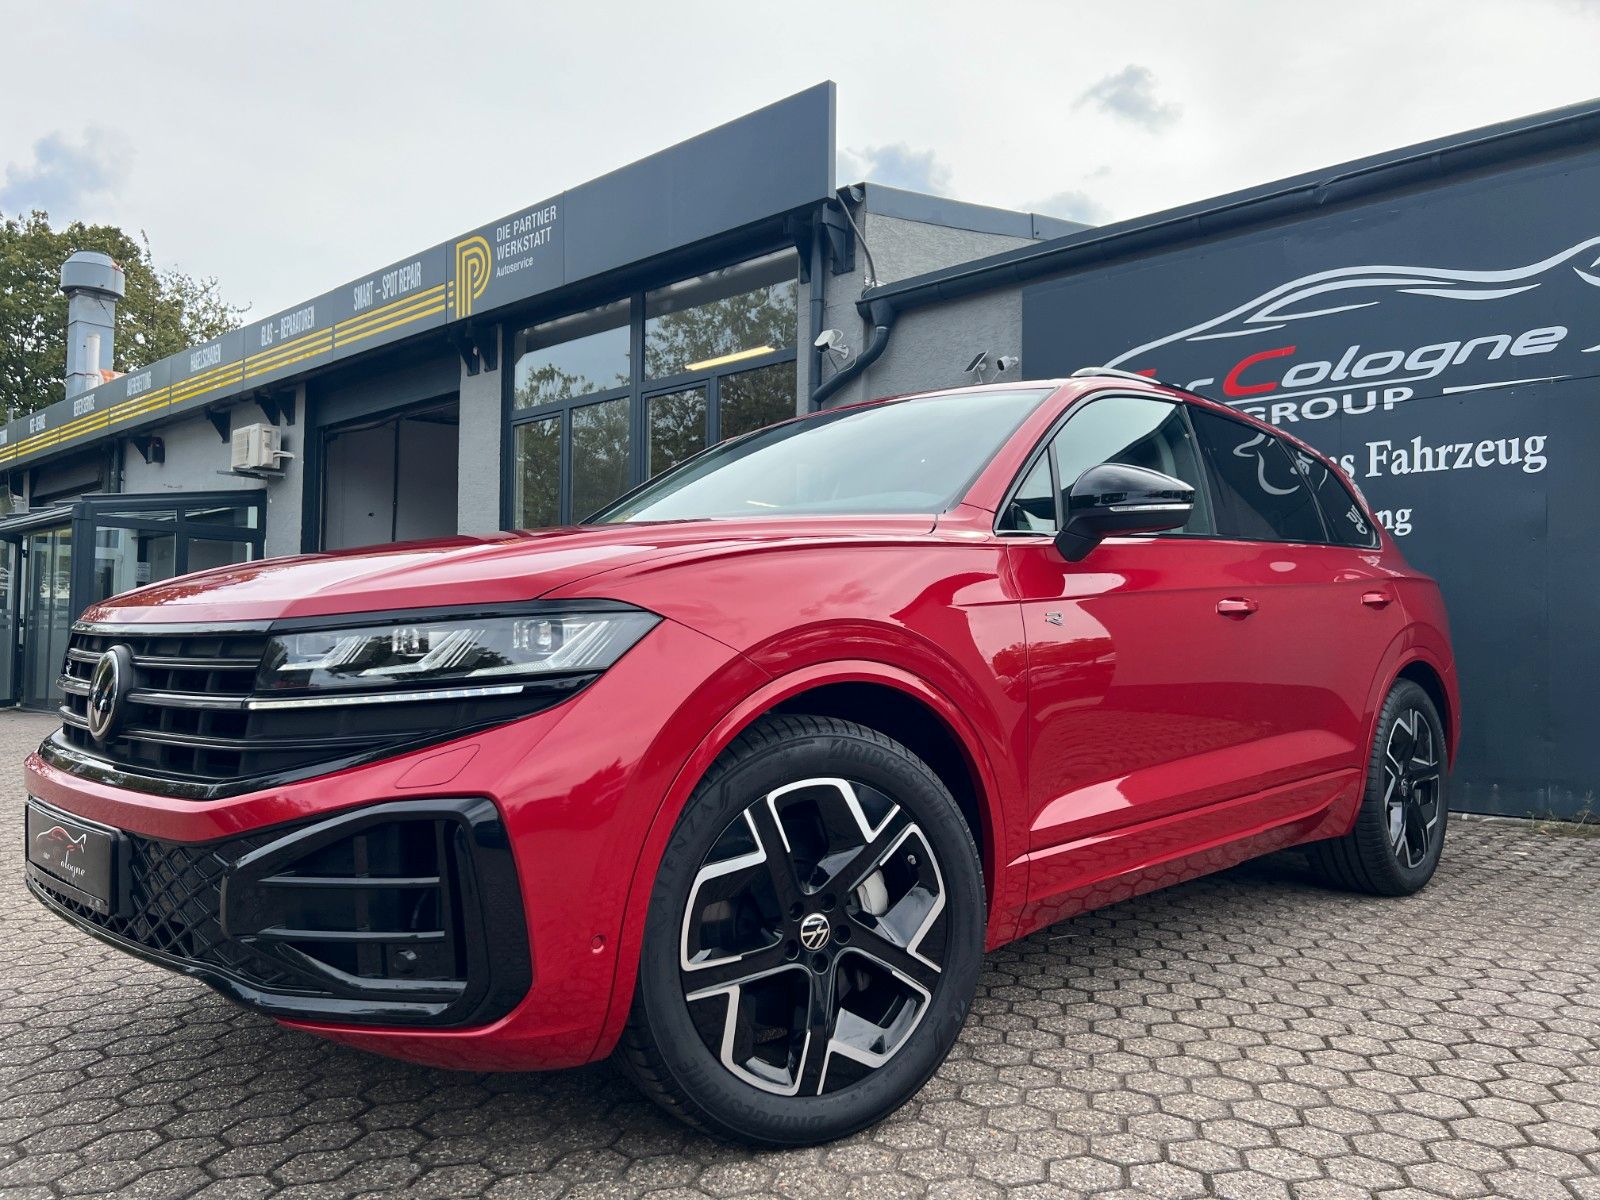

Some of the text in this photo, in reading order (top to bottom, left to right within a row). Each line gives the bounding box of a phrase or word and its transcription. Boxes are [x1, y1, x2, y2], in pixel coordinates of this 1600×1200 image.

[496, 205, 557, 243] DIE PARTNER
[496, 226, 552, 261] WERKSTATT
[353, 280, 374, 311] SMART
[382, 270, 398, 300] SPOT
[399, 261, 422, 294] REPAIR
[496, 256, 534, 278] Autoservice
[1222, 325, 1569, 397] Cologne
[1364, 435, 1548, 478] Fahrzeug
